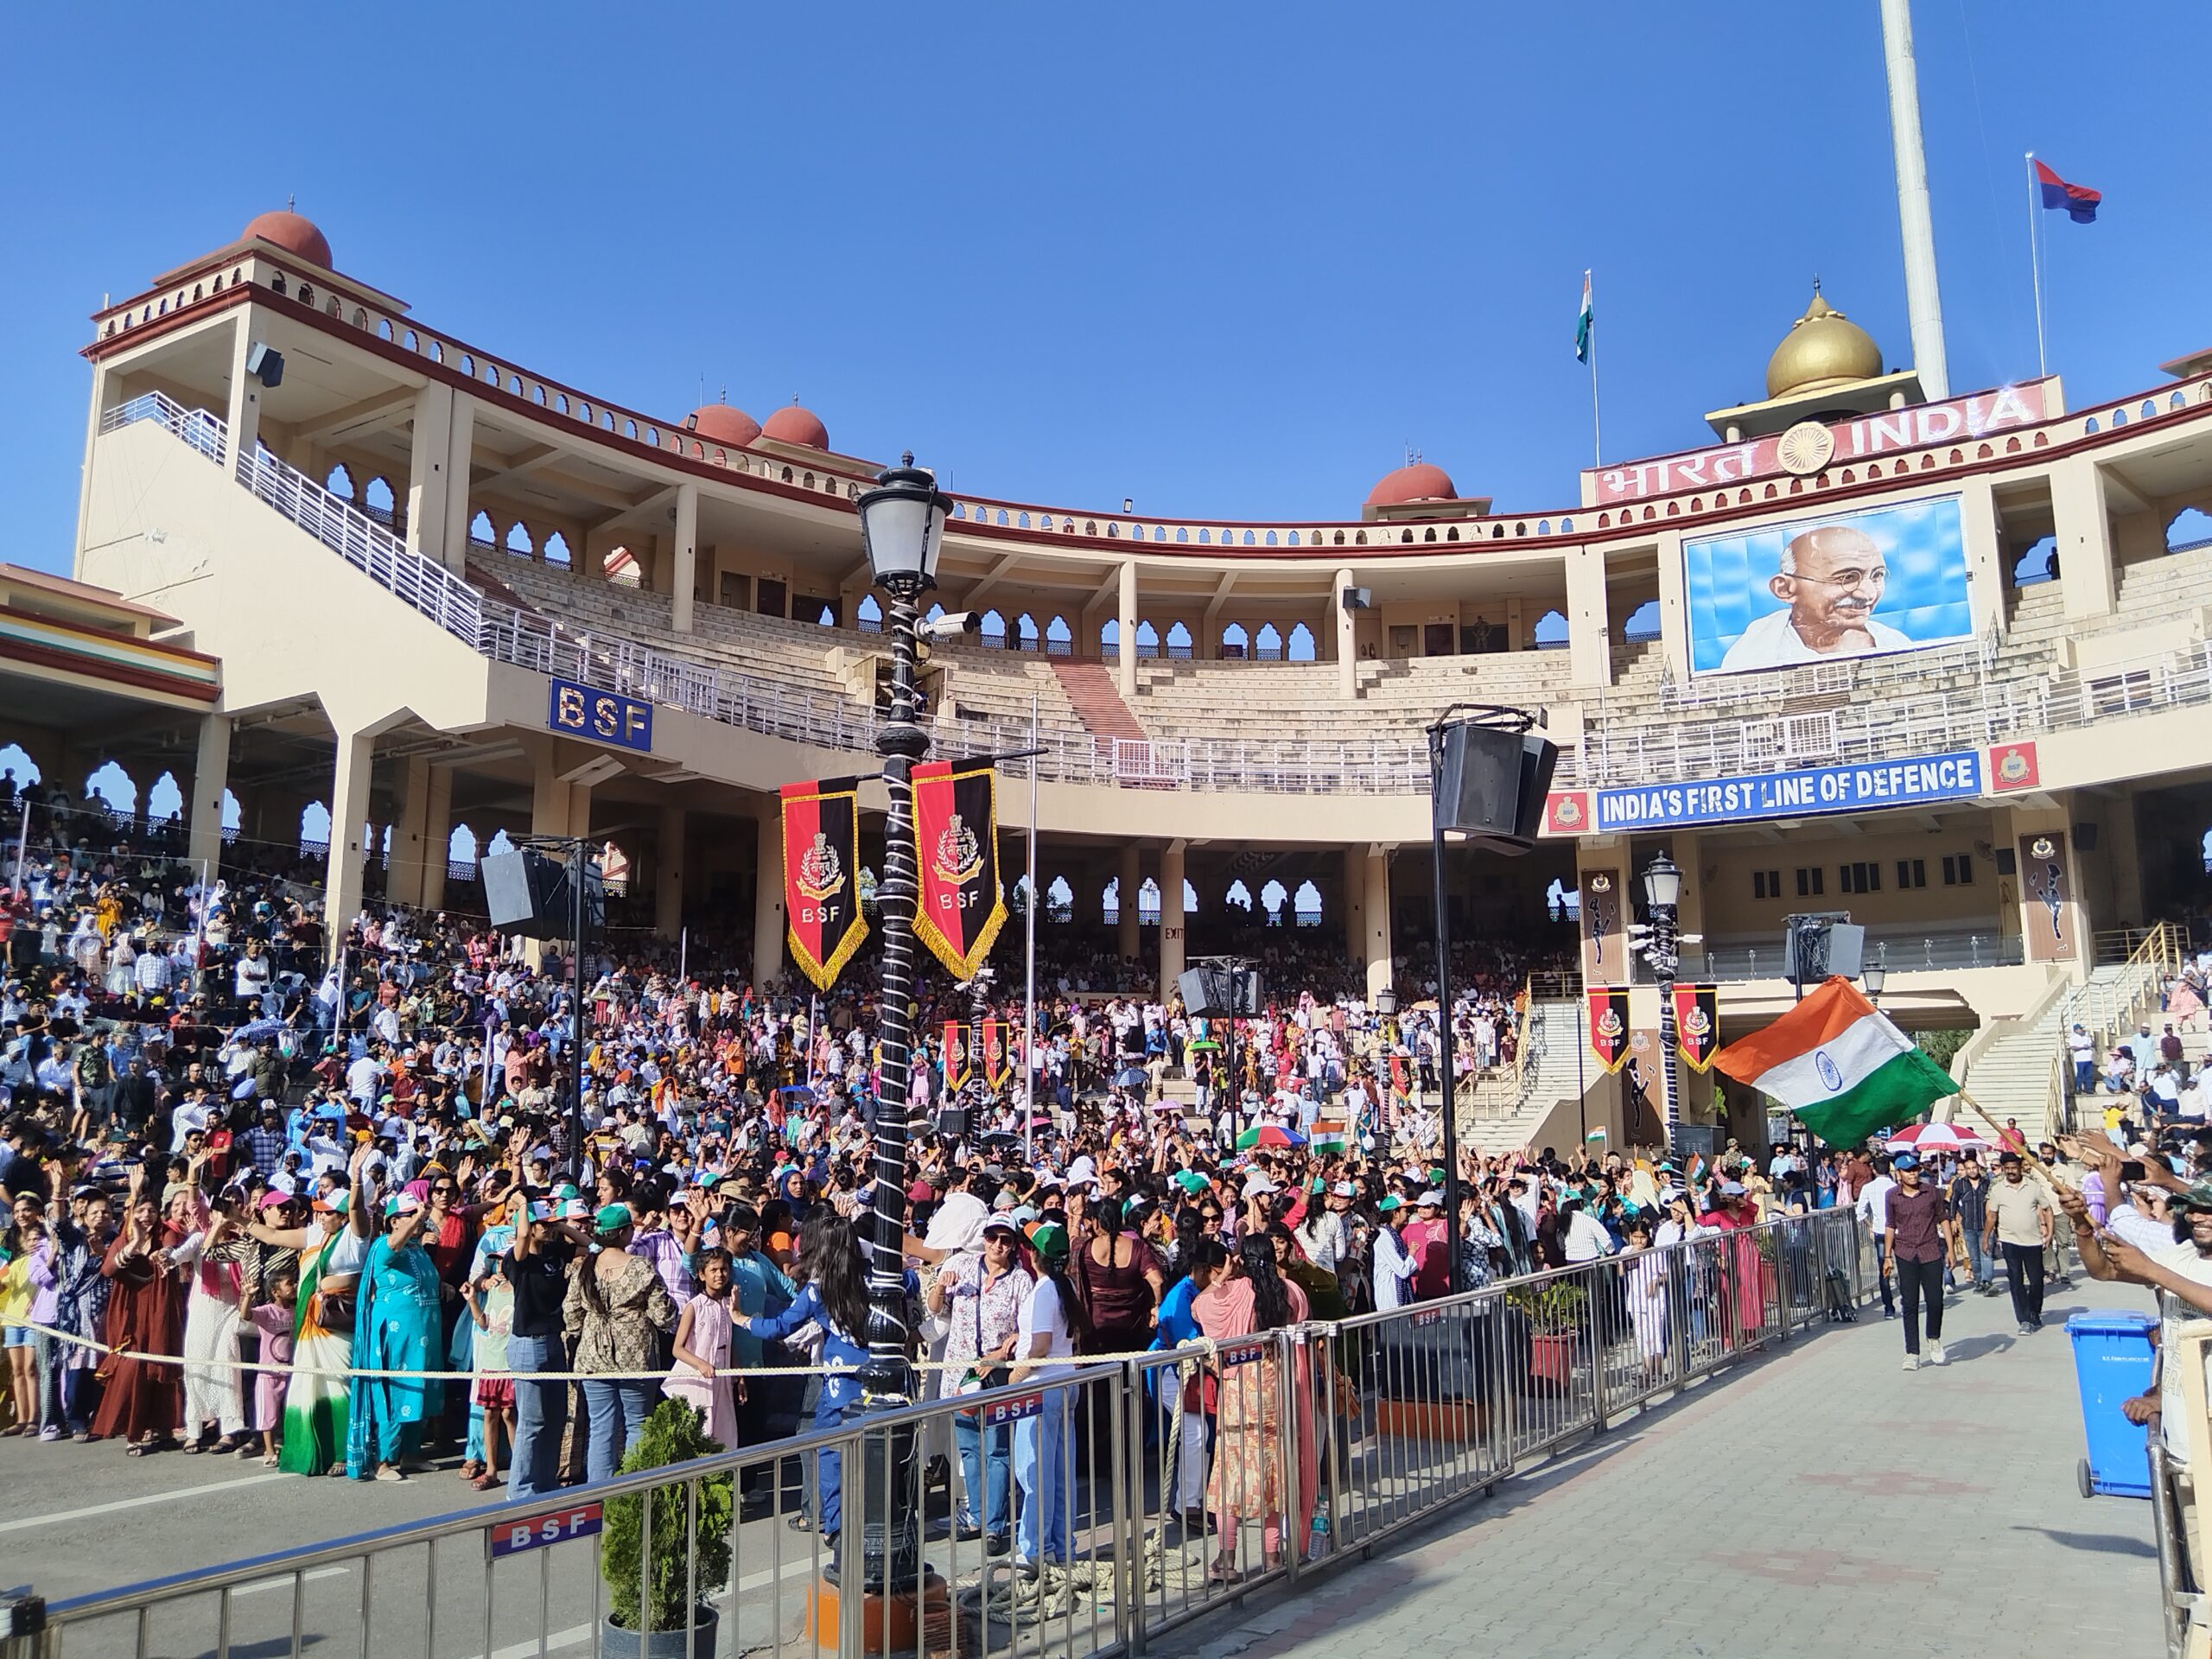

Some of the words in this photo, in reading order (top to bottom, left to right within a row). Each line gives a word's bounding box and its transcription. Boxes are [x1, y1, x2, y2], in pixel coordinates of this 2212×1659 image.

[1852, 391, 2034, 455] INDIA
[1603, 444, 1759, 498] भारत
[558, 686, 646, 741] BSF
[1603, 789, 1682, 823] INDIA'S
[1687, 783, 1755, 815] FIRST
[1761, 776, 1815, 808] LINE
[1820, 772, 1851, 802] OF
[1856, 759, 1974, 798] DEFENCE
[939, 891, 979, 910] BSF
[802, 906, 840, 924] BSF
[1165, 927, 1184, 940] EXIT
[1599, 1039, 1621, 1047] BSF
[1686, 1037, 1709, 1046] BSF
[1419, 1312, 1436, 1325] BSF
[1230, 1348, 1256, 1363] BSF
[995, 1399, 1034, 1421] BSF
[512, 1512, 586, 1548] BSF
